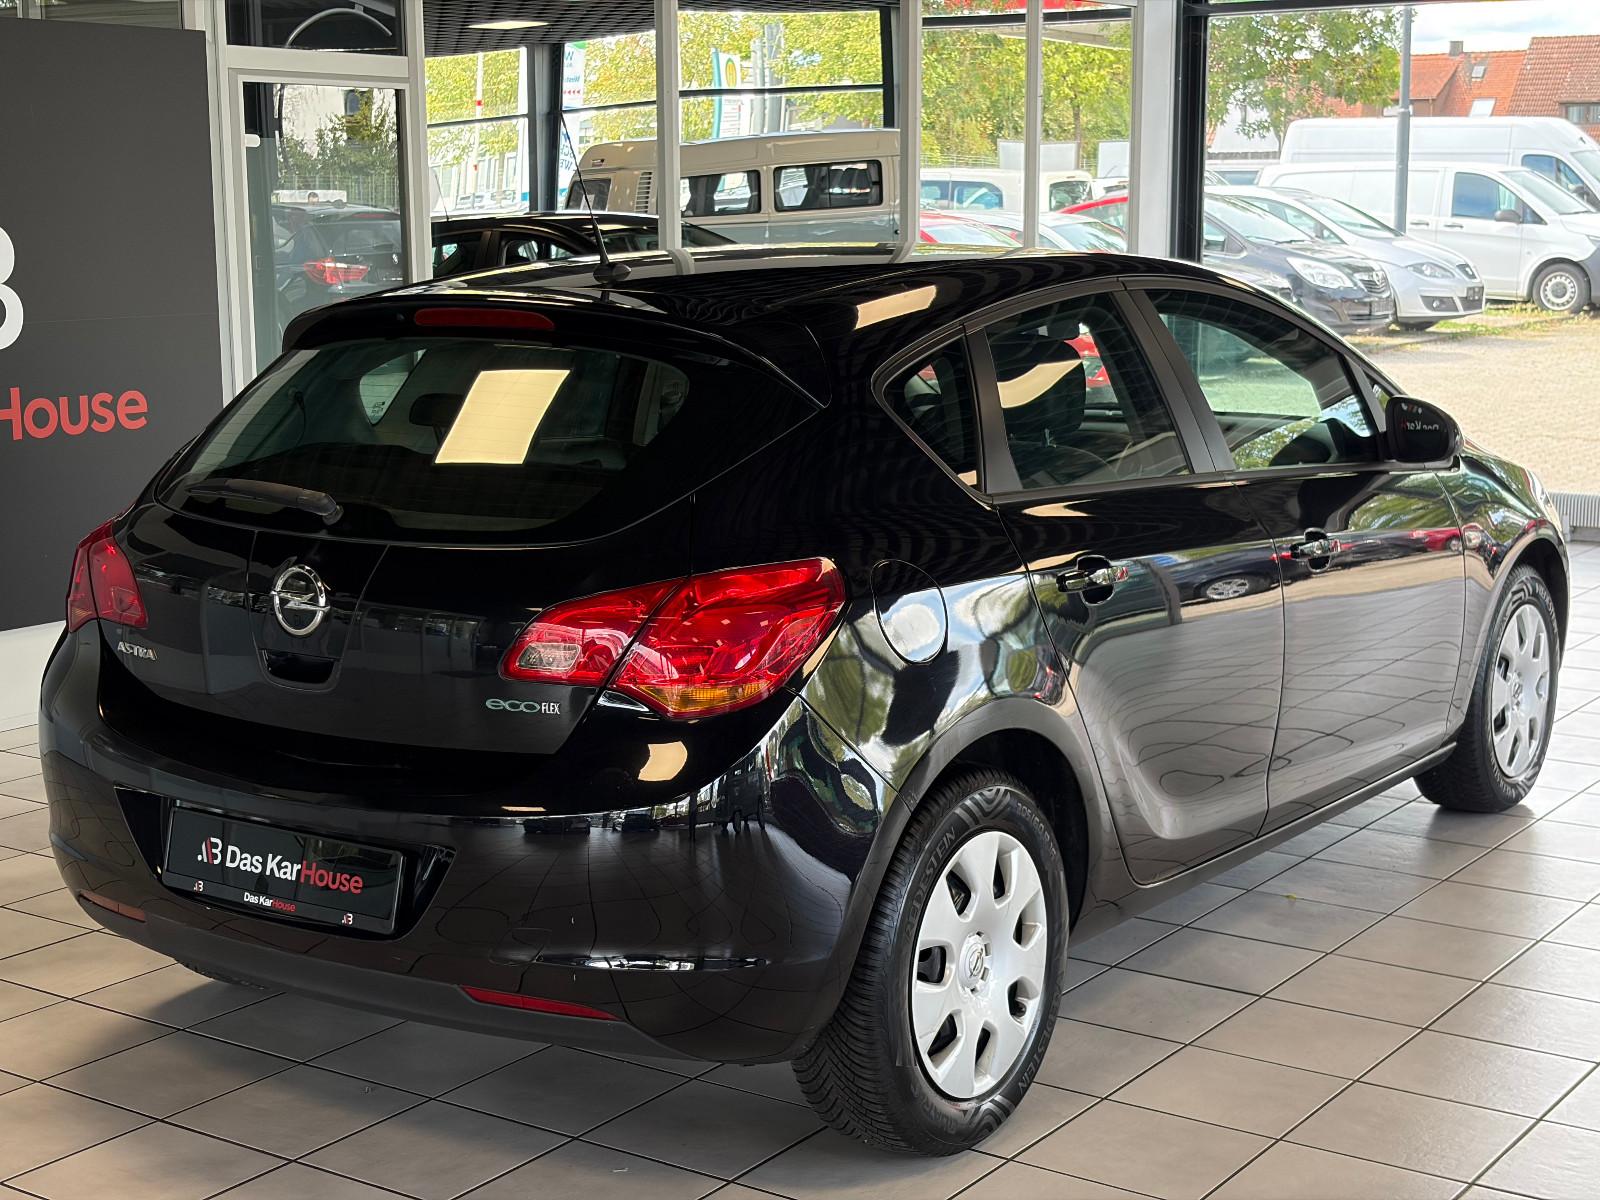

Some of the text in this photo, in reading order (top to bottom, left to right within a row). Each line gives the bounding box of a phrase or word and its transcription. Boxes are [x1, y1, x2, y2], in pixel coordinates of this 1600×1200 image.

[117, 641, 158, 661] ASTRA
[225, 845, 263, 874] Das
[243, 892, 259, 904] Das
